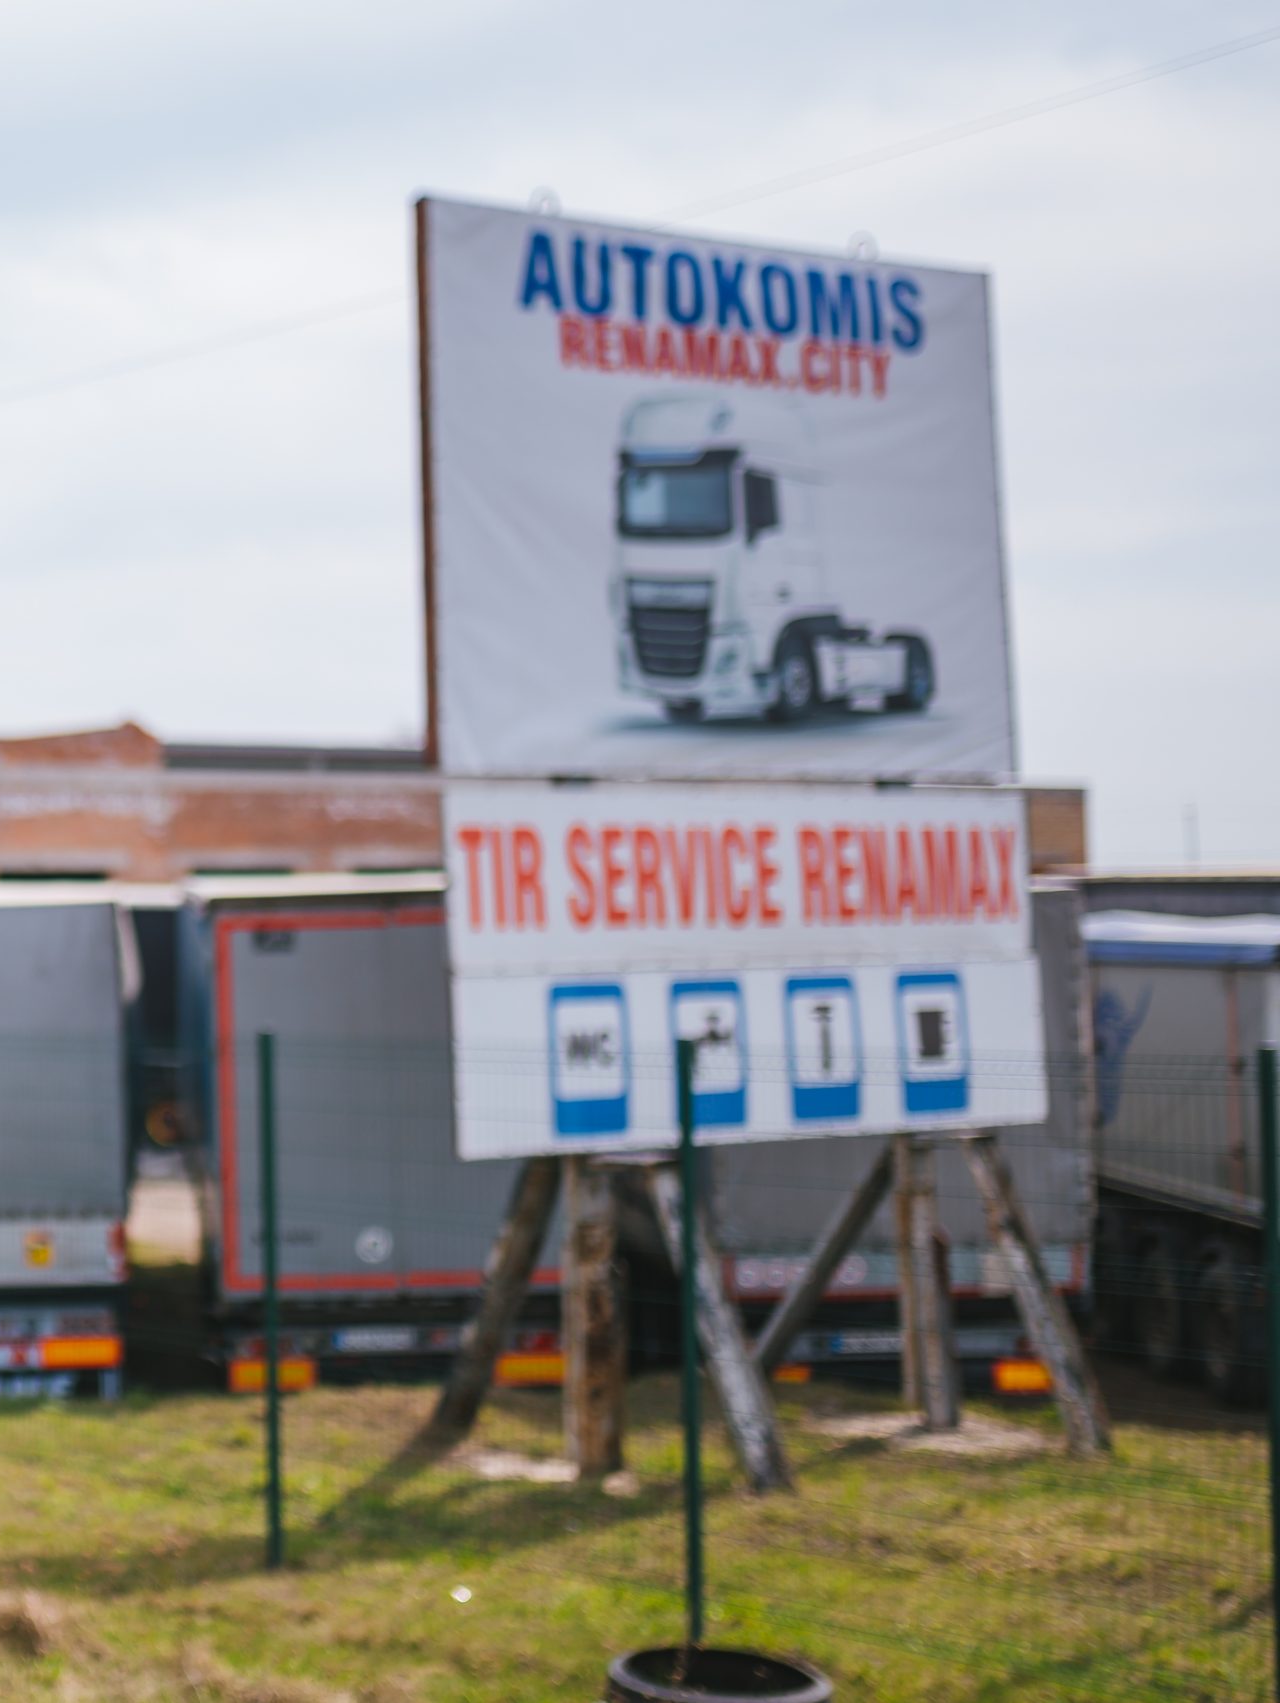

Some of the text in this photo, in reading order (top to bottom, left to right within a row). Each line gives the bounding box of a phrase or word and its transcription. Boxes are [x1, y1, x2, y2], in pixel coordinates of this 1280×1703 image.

[518, 226, 925, 355] AUTOKOMIS
[559, 313, 888, 396] RENAMAX.CITY
[457, 824, 1018, 928] TIR SERVICE RENAMAX
[566, 1031, 614, 1068] WC
